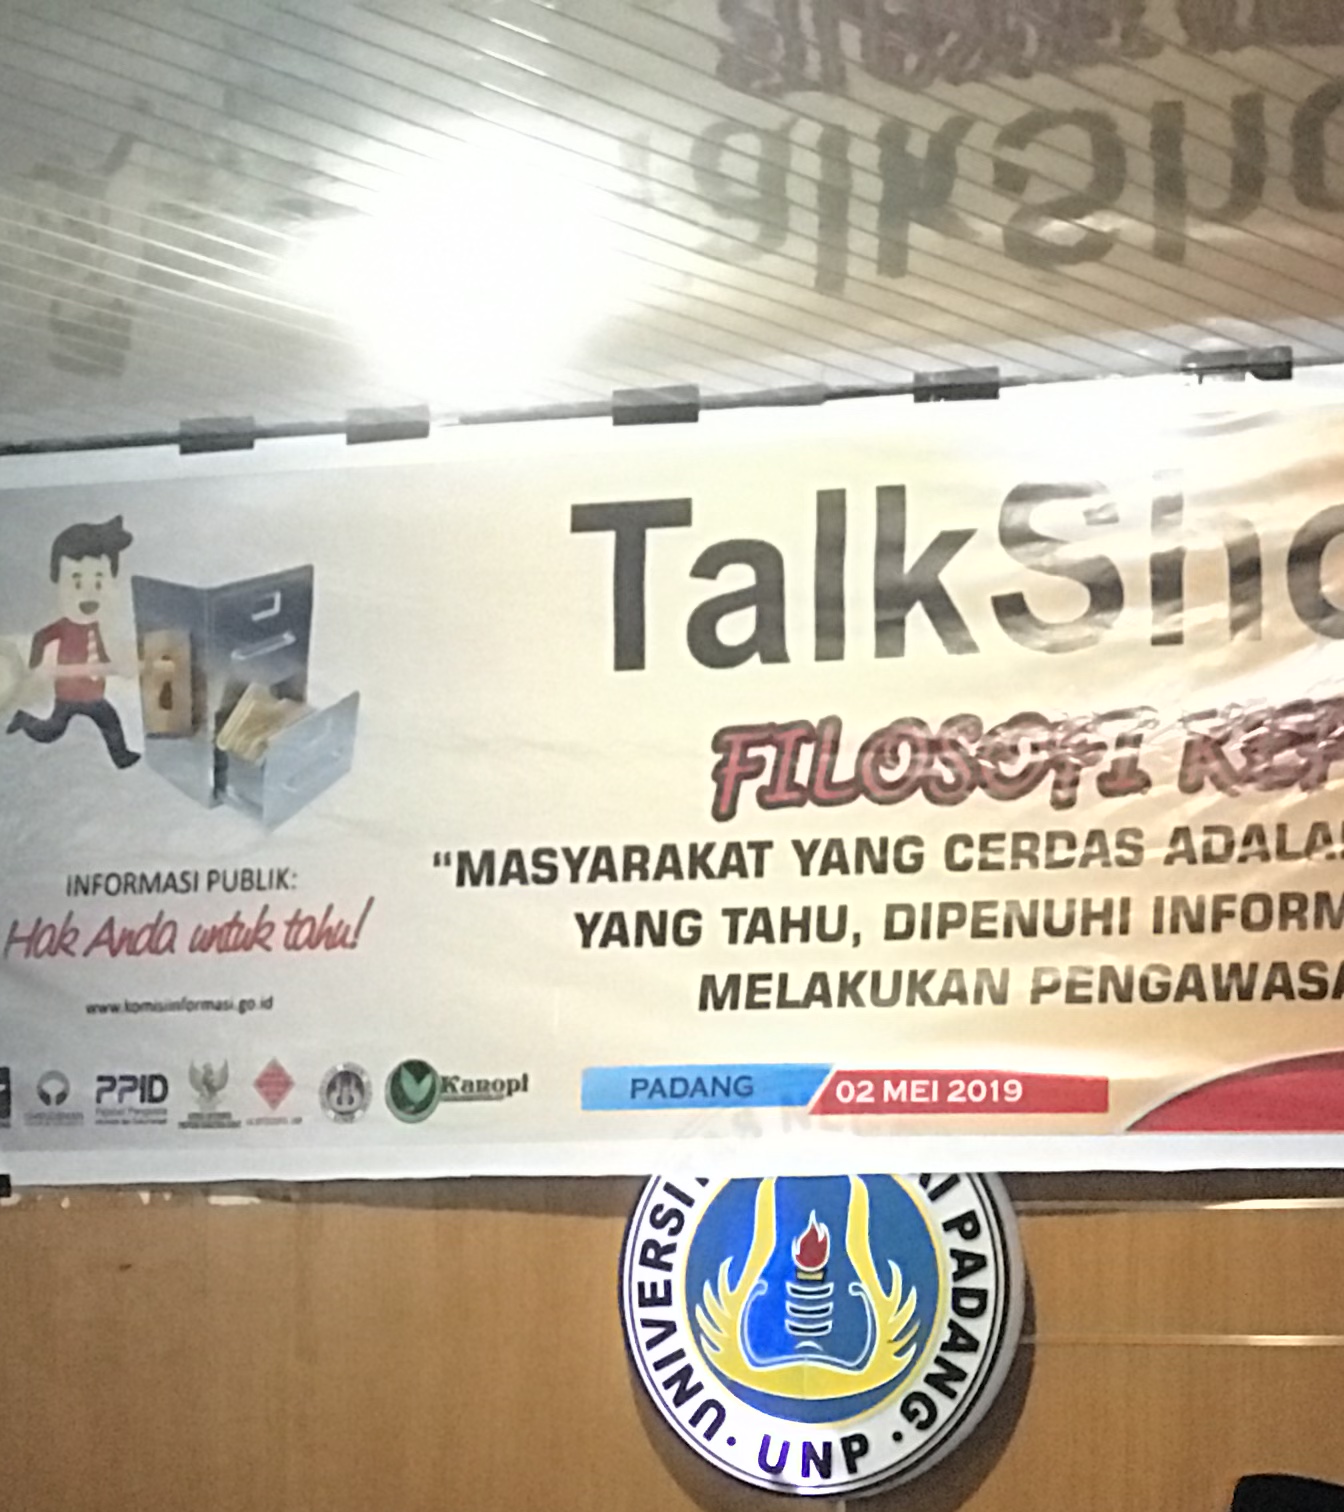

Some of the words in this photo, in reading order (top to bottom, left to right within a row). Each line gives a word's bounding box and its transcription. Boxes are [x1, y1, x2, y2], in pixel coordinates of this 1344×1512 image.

[712, 707, 1156, 822] FILOSOFI
[792, 836, 924, 876] YANG
[944, 827, 1144, 870] CERDAS
[66, 871, 199, 897] INFORMASI
[207, 867, 298, 892] PUBLIK:
[3, 909, 80, 959] Hak
[82, 909, 177, 957] Anda
[188, 904, 275, 955] untuk
[283, 896, 375, 951] tahu!
[574, 911, 703, 949] YANG
[721, 905, 862, 947] TAHU,
[883, 895, 1130, 941] DIPENUHI
[698, 967, 1010, 1011] MELAKUKAN
[95, 1073, 169, 1104] PPID
[631, 1075, 754, 1100] PADANG
[836, 1079, 875, 1103] 02
[884, 1079, 939, 1103] MEI
[947, 1079, 1023, 1103] 2019
[637, 1175, 727, 1441] UNIVERSI
[900, 1209, 989, 1431] PADANG
[757, 1432, 870, 1480] UNP
